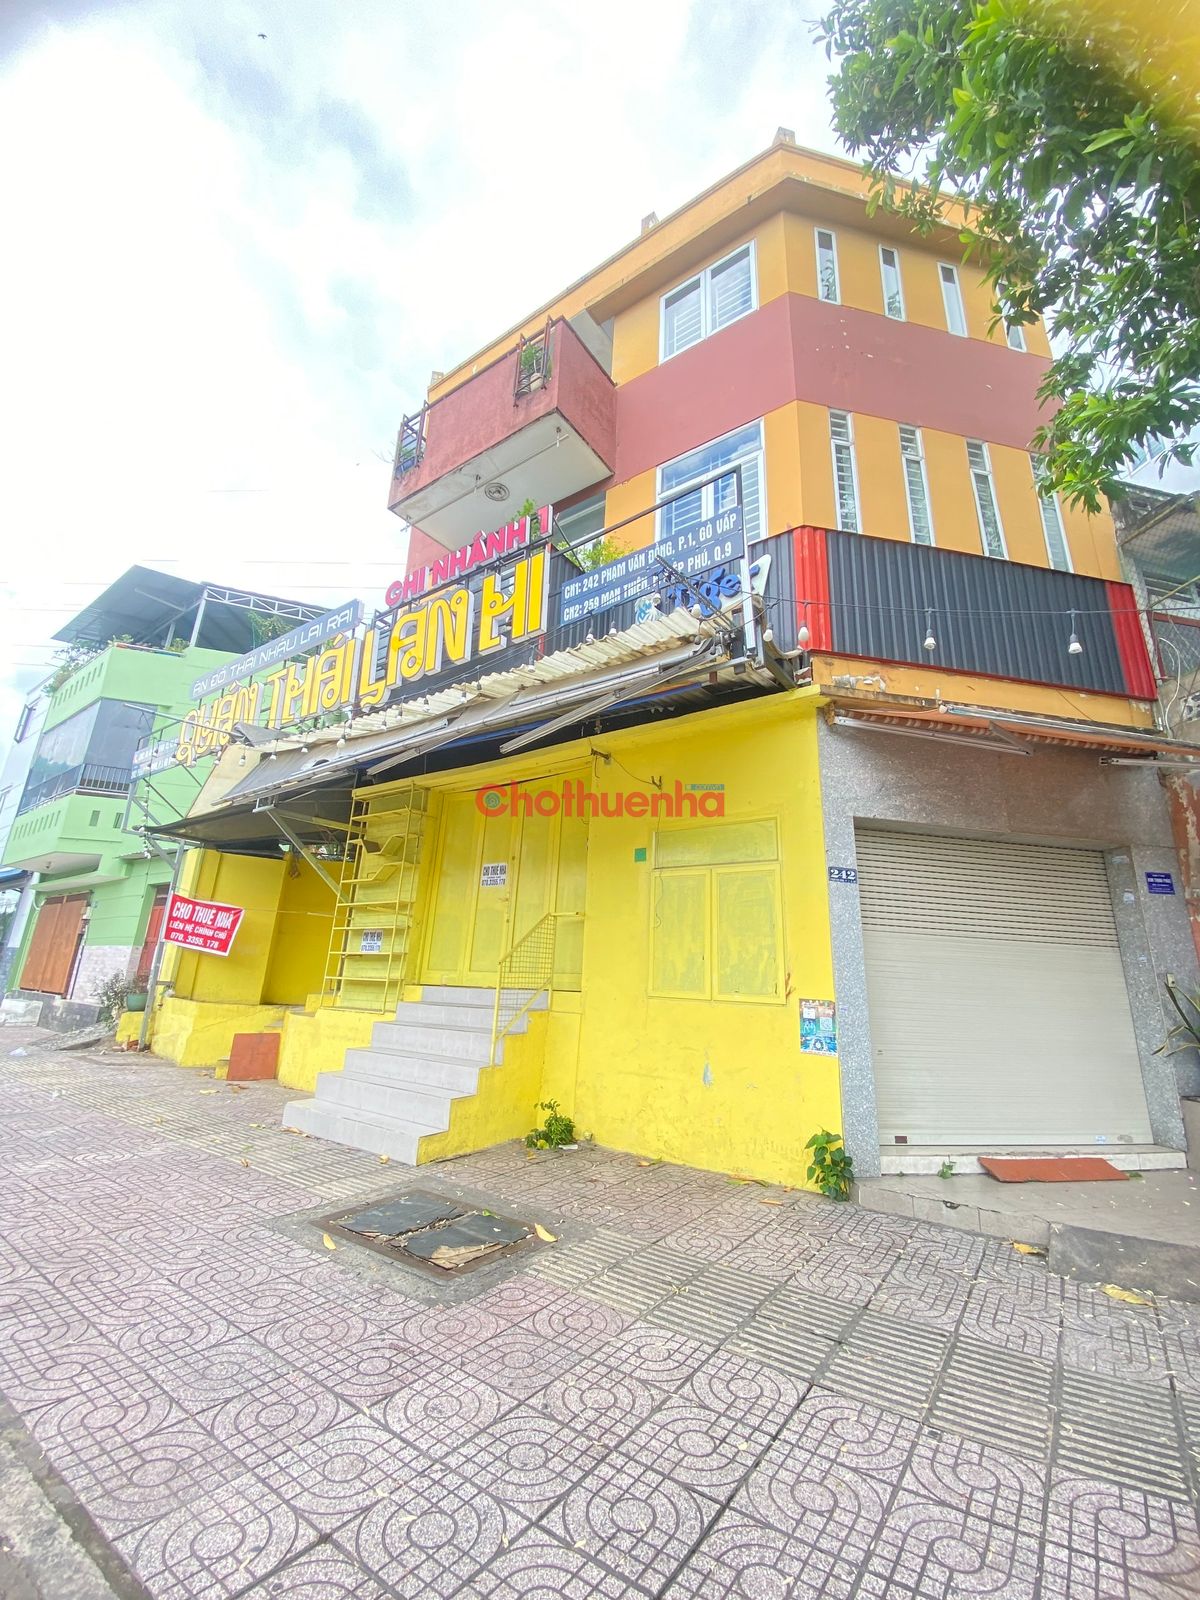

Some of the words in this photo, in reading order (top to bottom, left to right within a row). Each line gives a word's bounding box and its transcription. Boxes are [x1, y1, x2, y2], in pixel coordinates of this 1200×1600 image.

[430, 516, 529, 586] NHÁNH
[537, 504, 550, 536] 1
[583, 574, 599, 592] 242
[601, 563, 626, 585] PHẠM
[628, 553, 646, 572] VĂN
[699, 522, 713, 542] GÒ
[716, 511, 737, 535] VẤP
[583, 596, 600, 614] 259
[714, 542, 732, 561] Q.9
[259, 636, 297, 665] NHẬU
[300, 621, 323, 645] LAI
[326, 607, 354, 633] RAI
[267, 633, 356, 730] THÁI
[830, 869, 856, 880] 242
[172, 901, 193, 920] CHO
[192, 906, 217, 925] THUÊ
[206, 939, 220, 949] 178
